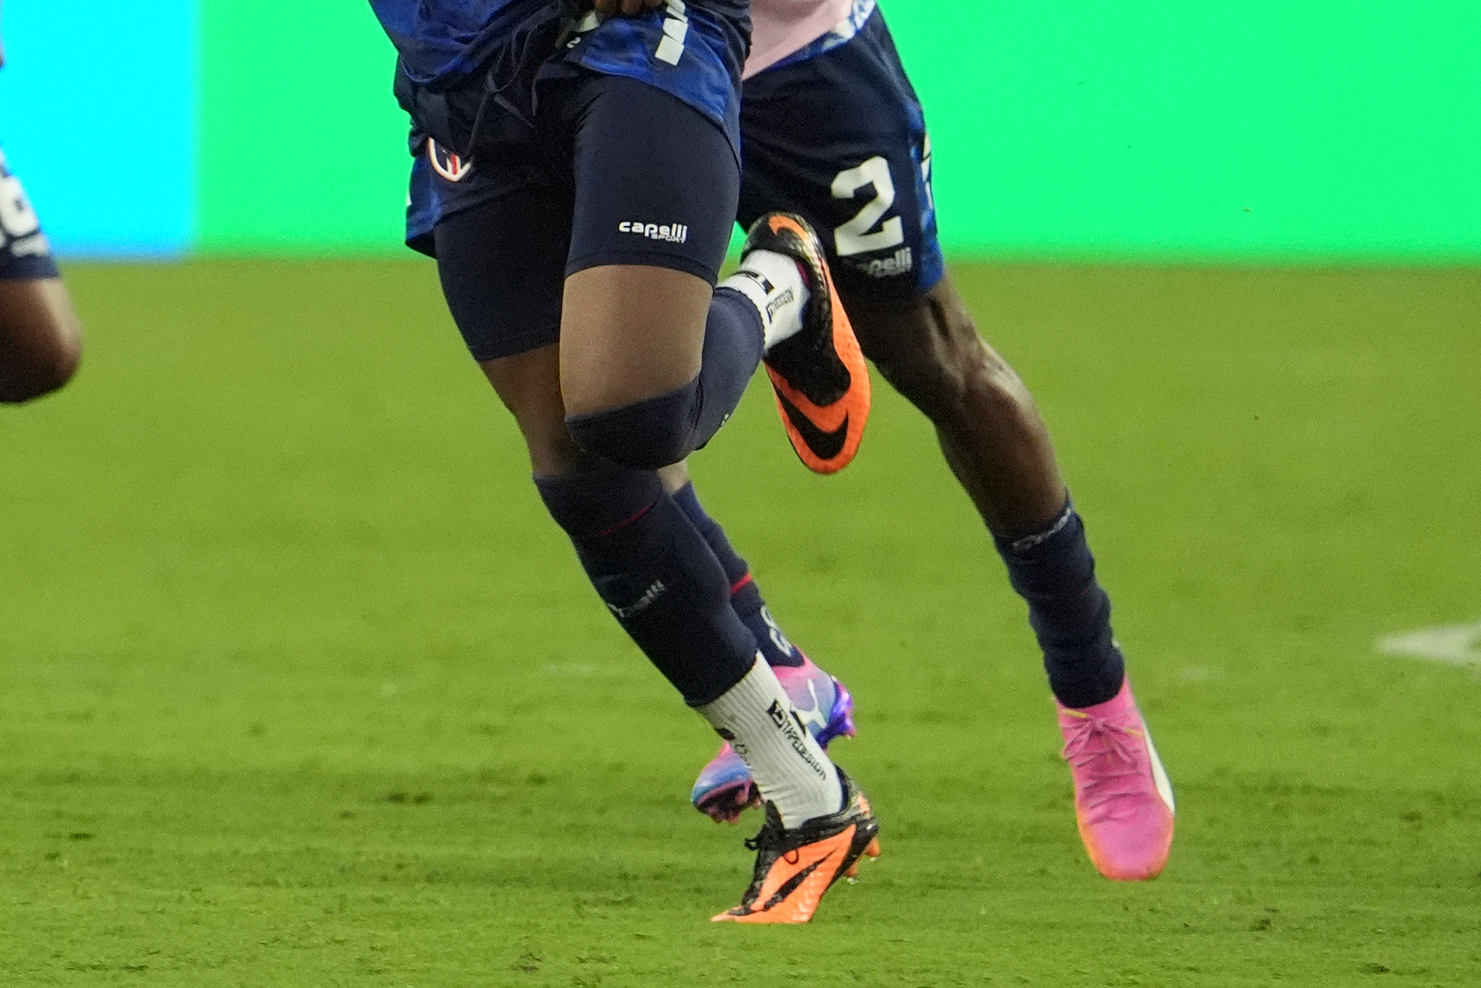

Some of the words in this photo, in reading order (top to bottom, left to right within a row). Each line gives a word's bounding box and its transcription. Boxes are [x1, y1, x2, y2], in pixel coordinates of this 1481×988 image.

[830, 155, 905, 257] 2
[618, 220, 689, 241] capelli
[650, 232, 688, 245] SPORT
